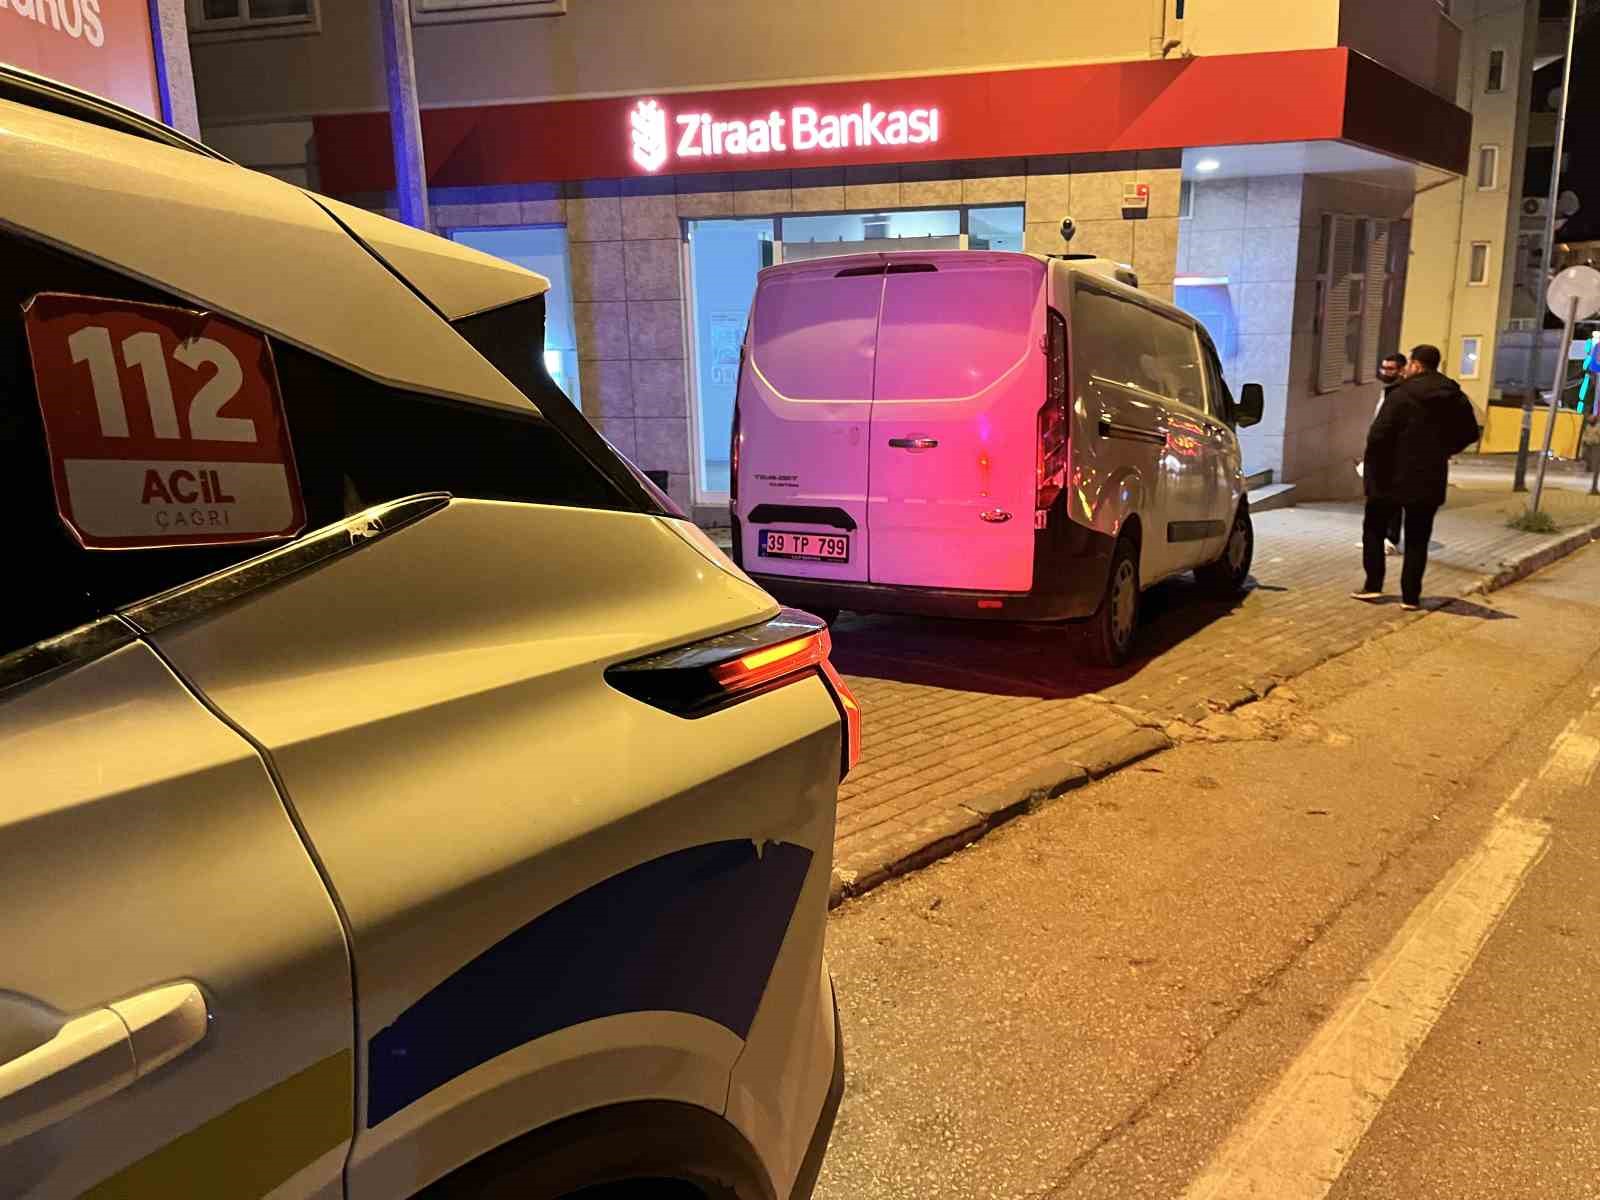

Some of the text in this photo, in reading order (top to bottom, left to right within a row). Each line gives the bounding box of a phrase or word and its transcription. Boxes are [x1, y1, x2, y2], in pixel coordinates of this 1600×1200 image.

[675, 102, 939, 157] Ziraat Bankası
[67, 326, 258, 443] 112
[140, 468, 236, 505] ACİL
[154, 508, 230, 530] ÇAĞRI
[768, 535, 845, 556] 39 TP 799
